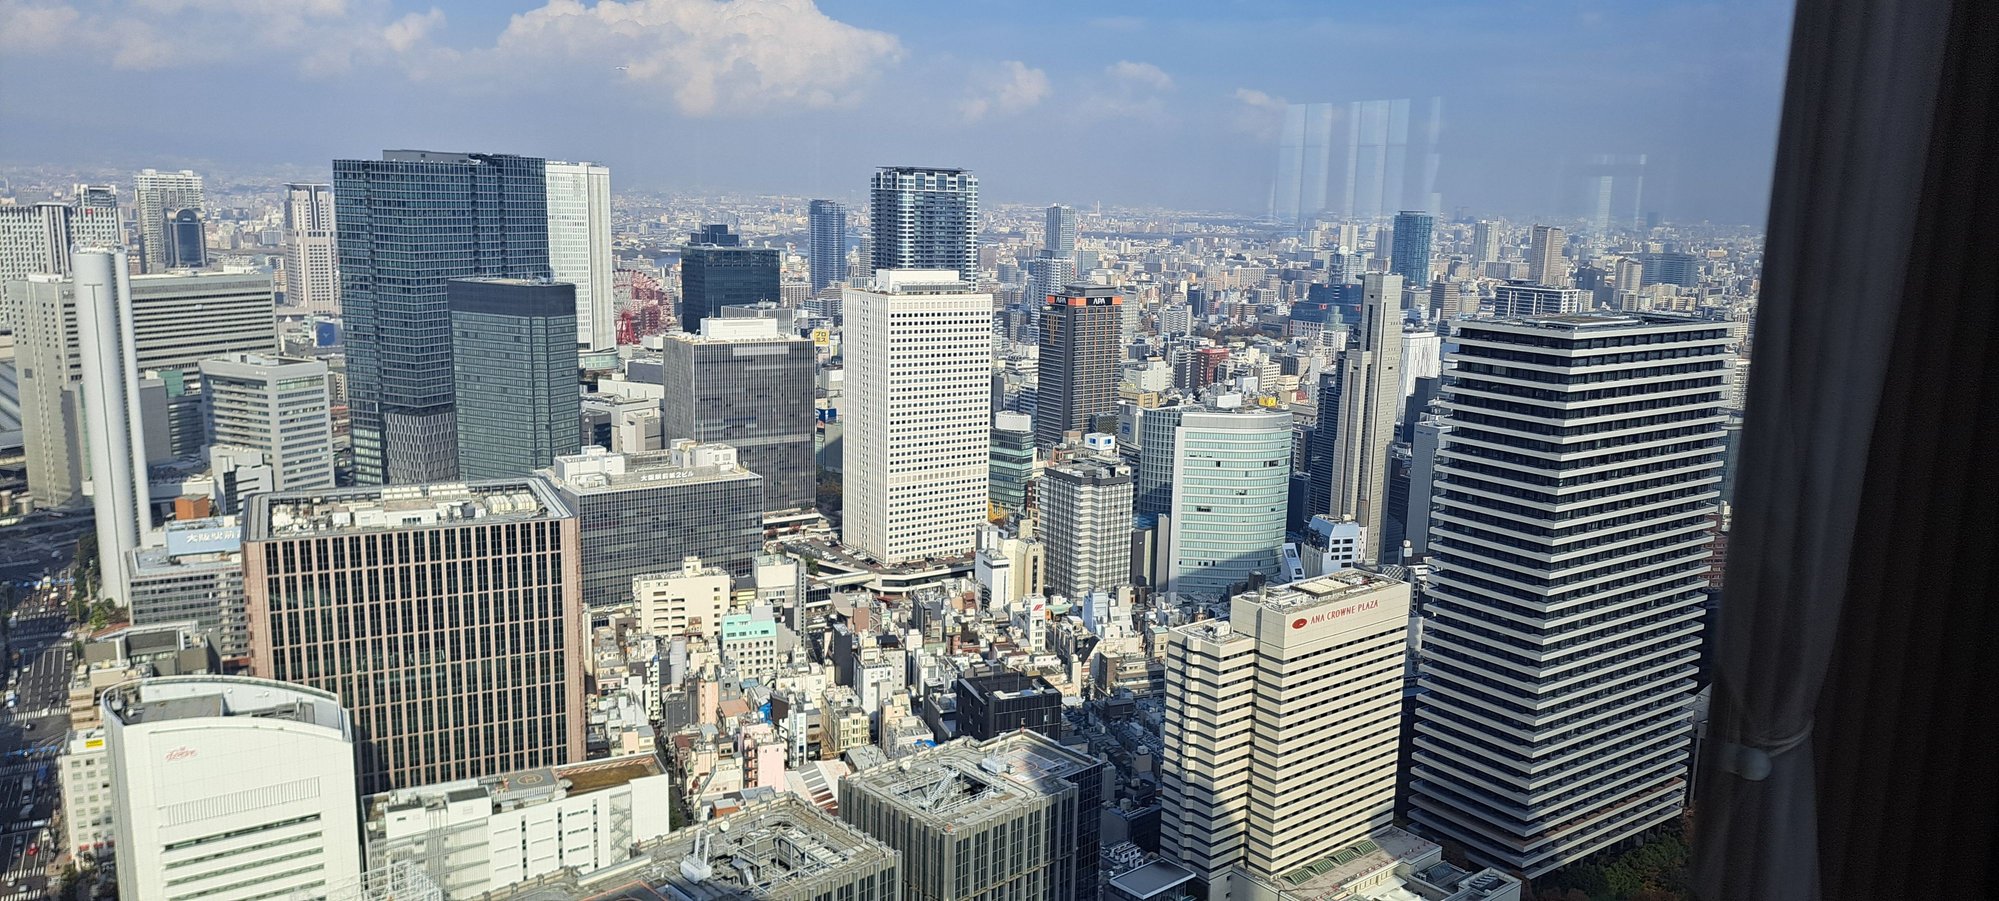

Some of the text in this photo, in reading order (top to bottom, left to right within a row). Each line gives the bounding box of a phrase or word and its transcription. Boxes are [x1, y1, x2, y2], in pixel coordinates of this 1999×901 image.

[1056, 296, 1066, 304] APA
[1093, 297, 1105, 305] APA
[1310, 599, 1379, 625] ANA CROWNE PLAZA
